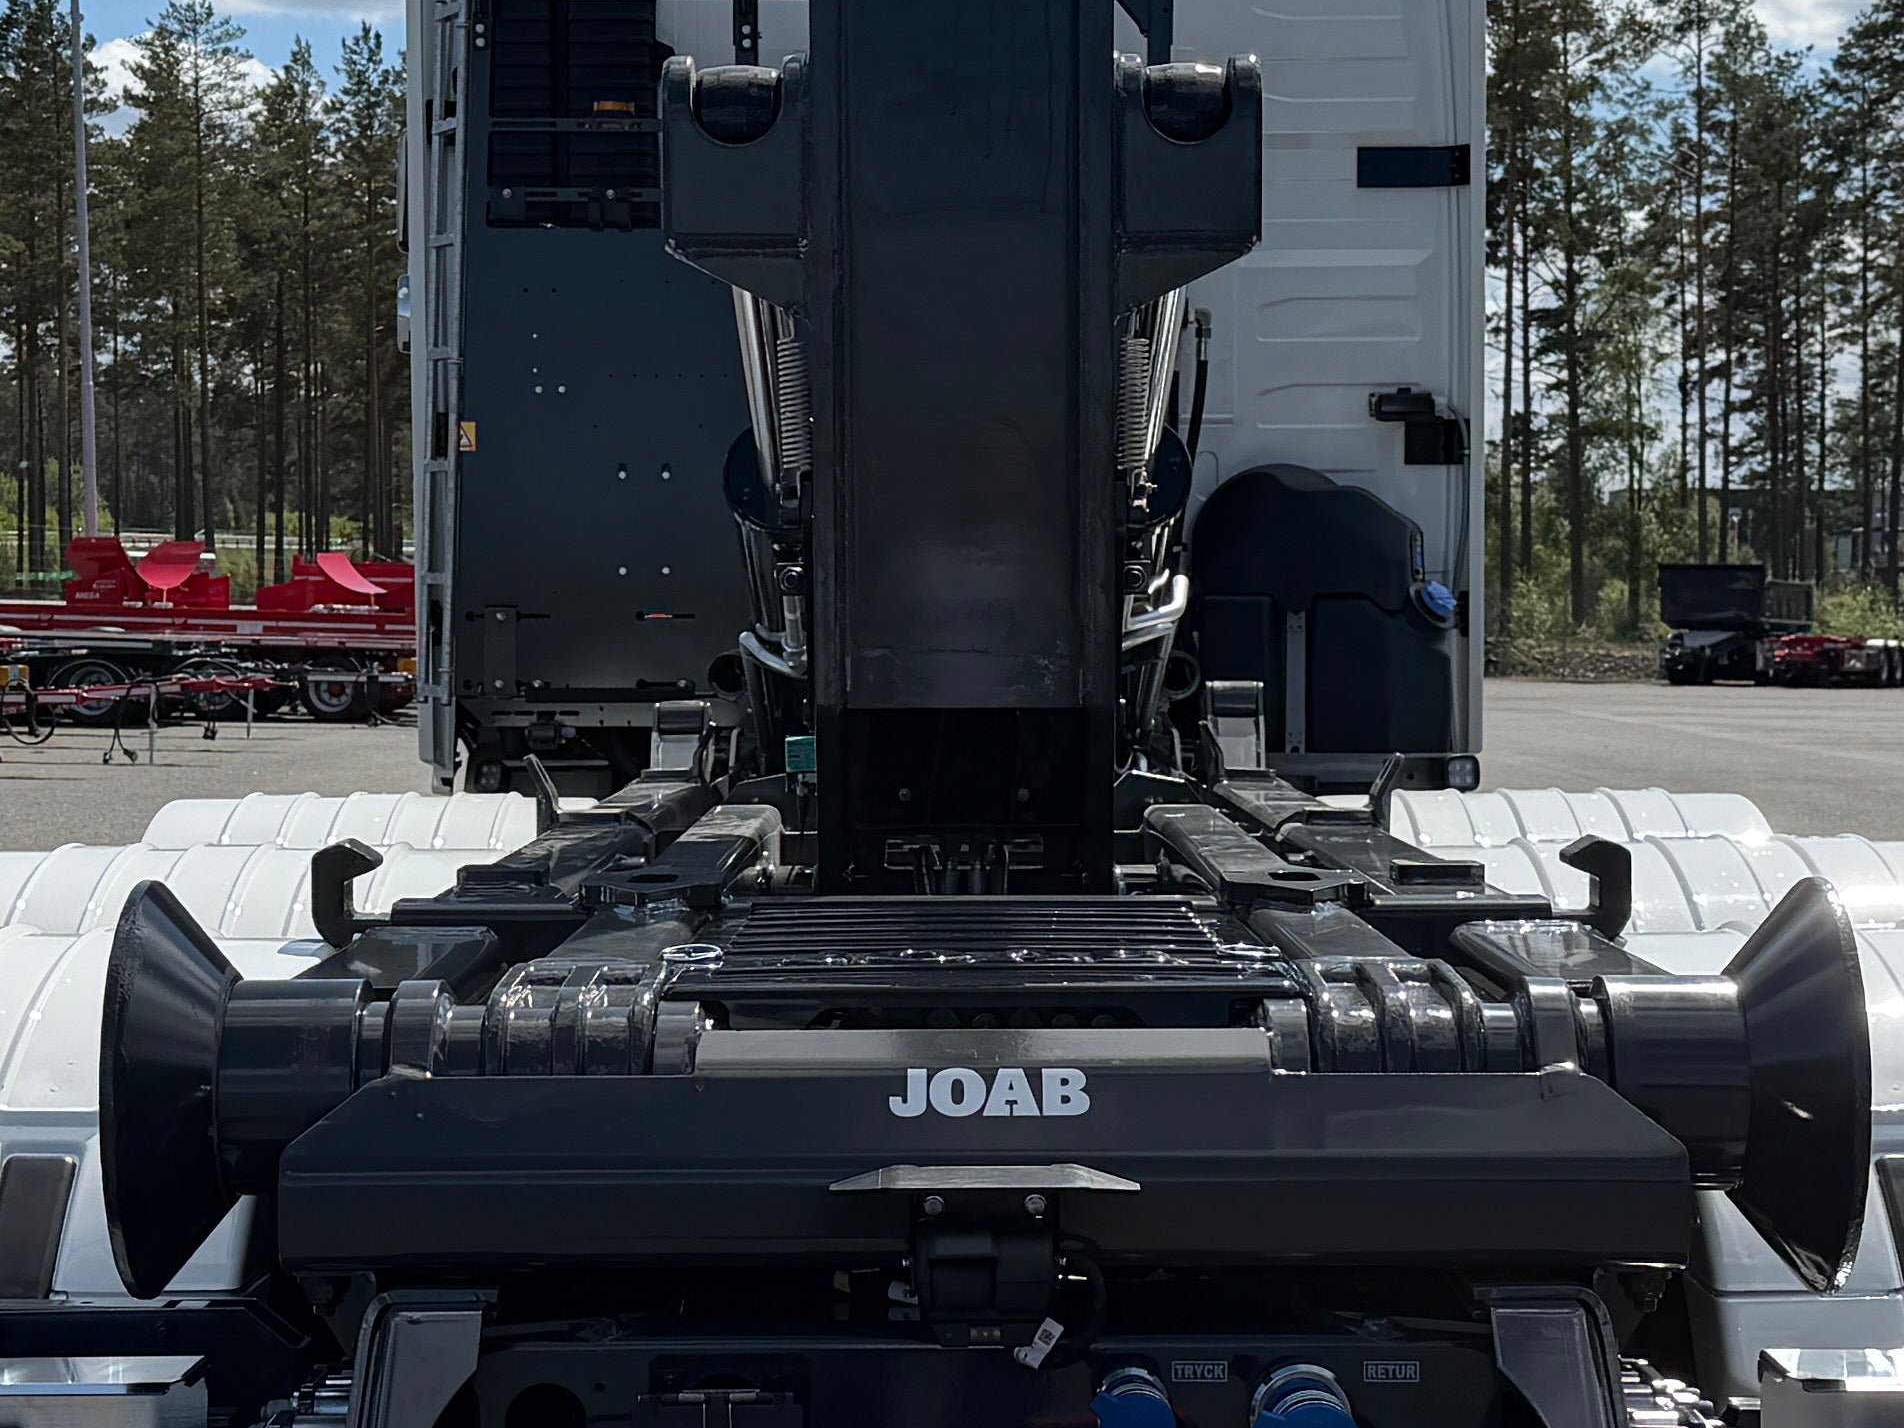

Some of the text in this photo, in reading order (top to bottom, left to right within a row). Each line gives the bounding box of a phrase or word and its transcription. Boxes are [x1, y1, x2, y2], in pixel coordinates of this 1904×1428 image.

[889, 1067, 1090, 1117] JOAB
[1175, 1364, 1224, 1379] TRYCK
[1367, 1364, 1416, 1379] RETUR
